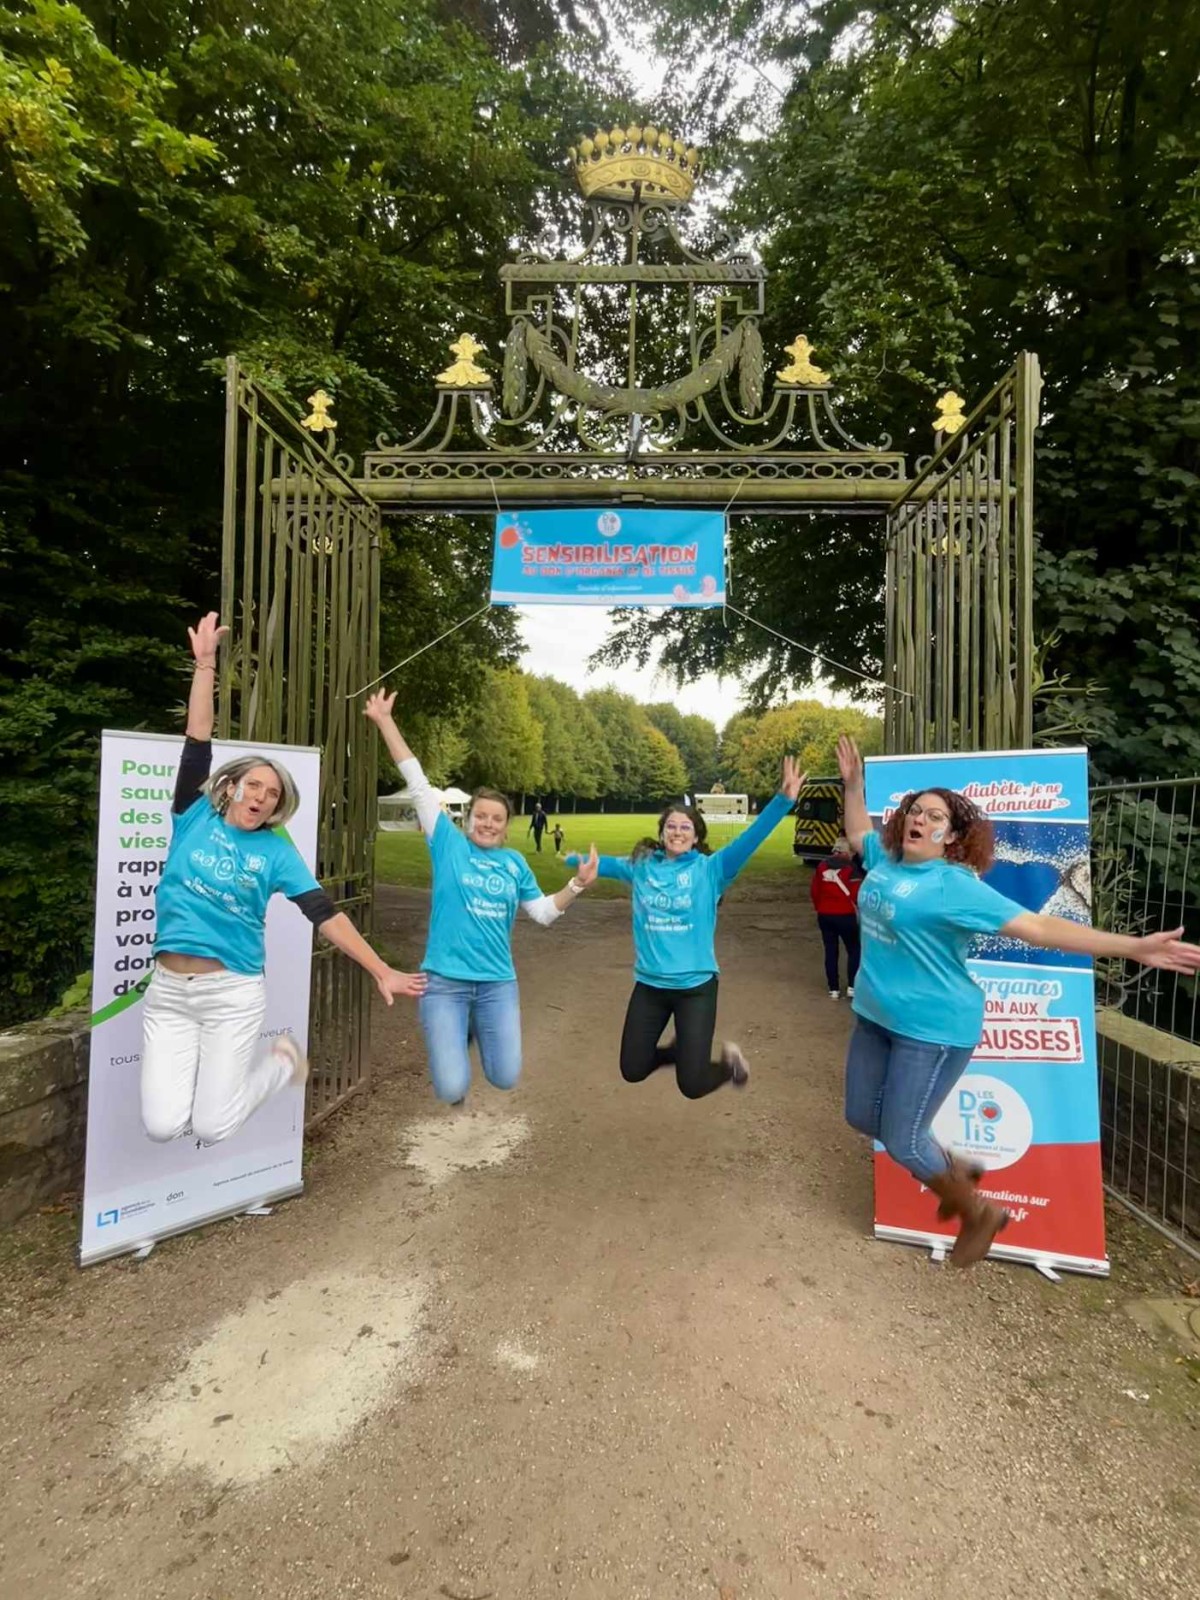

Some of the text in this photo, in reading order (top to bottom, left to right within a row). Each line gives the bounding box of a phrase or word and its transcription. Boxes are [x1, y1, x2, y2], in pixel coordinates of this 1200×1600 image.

[522, 543, 698, 565] SENSIBILISATION
[122, 760, 176, 776] Pour
[121, 787, 175, 800] sauv
[1030, 784, 1042, 797] je
[1045, 784, 1061, 794] ne
[119, 808, 163, 824] des
[119, 831, 167, 848] vies
[117, 880, 132, 898] à
[116, 908, 155, 927] pro
[115, 933, 158, 947] vou
[113, 979, 149, 996] d'o
[984, 999, 1038, 1015] ON AUX
[977, 1029, 1070, 1051] AUSSES
[110, 1053, 141, 1066] tous
[977, 1090, 994, 1099] LES
[166, 1190, 184, 1201] don
[1029, 1196, 1051, 1206] sur
